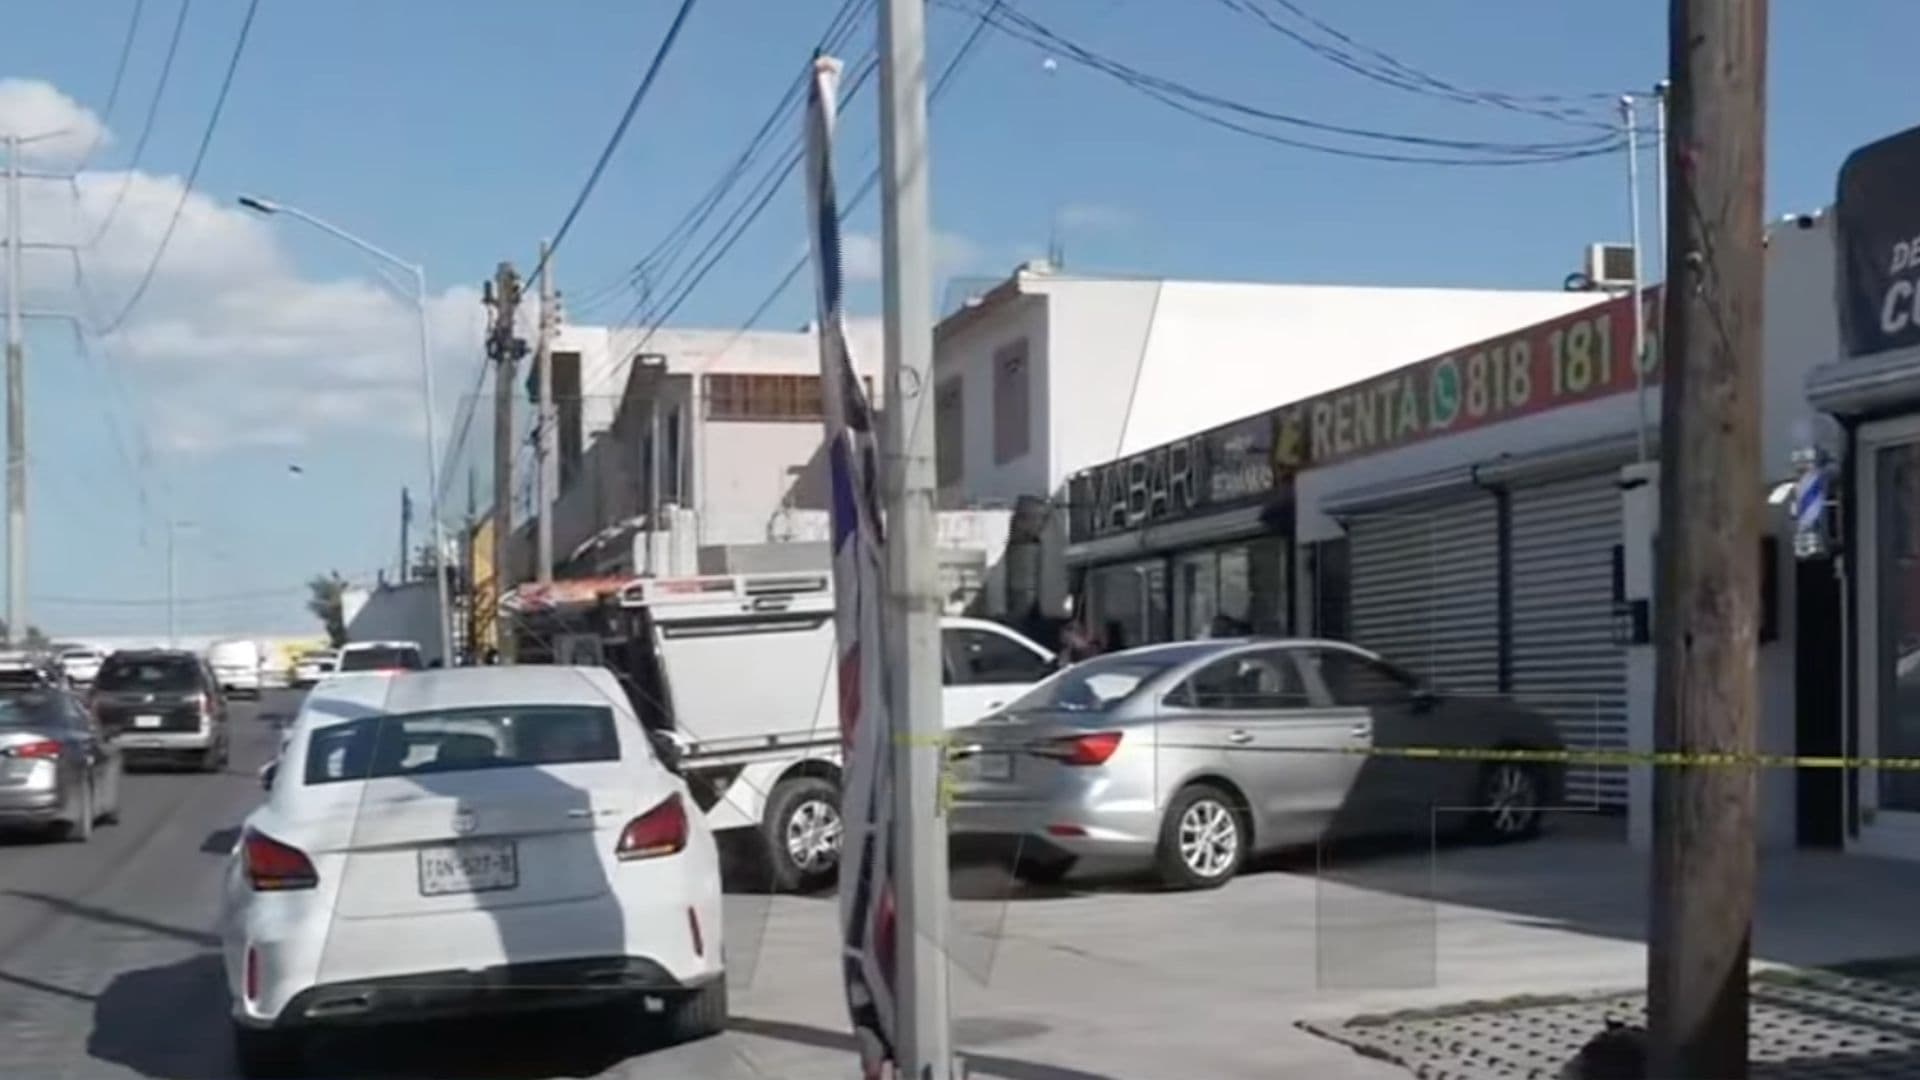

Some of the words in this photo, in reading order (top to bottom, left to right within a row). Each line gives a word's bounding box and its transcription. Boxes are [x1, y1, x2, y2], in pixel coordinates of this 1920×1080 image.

[1311, 380, 1419, 462] RENTA
[1467, 341, 1531, 418] 818
[1549, 314, 1613, 394] 181
